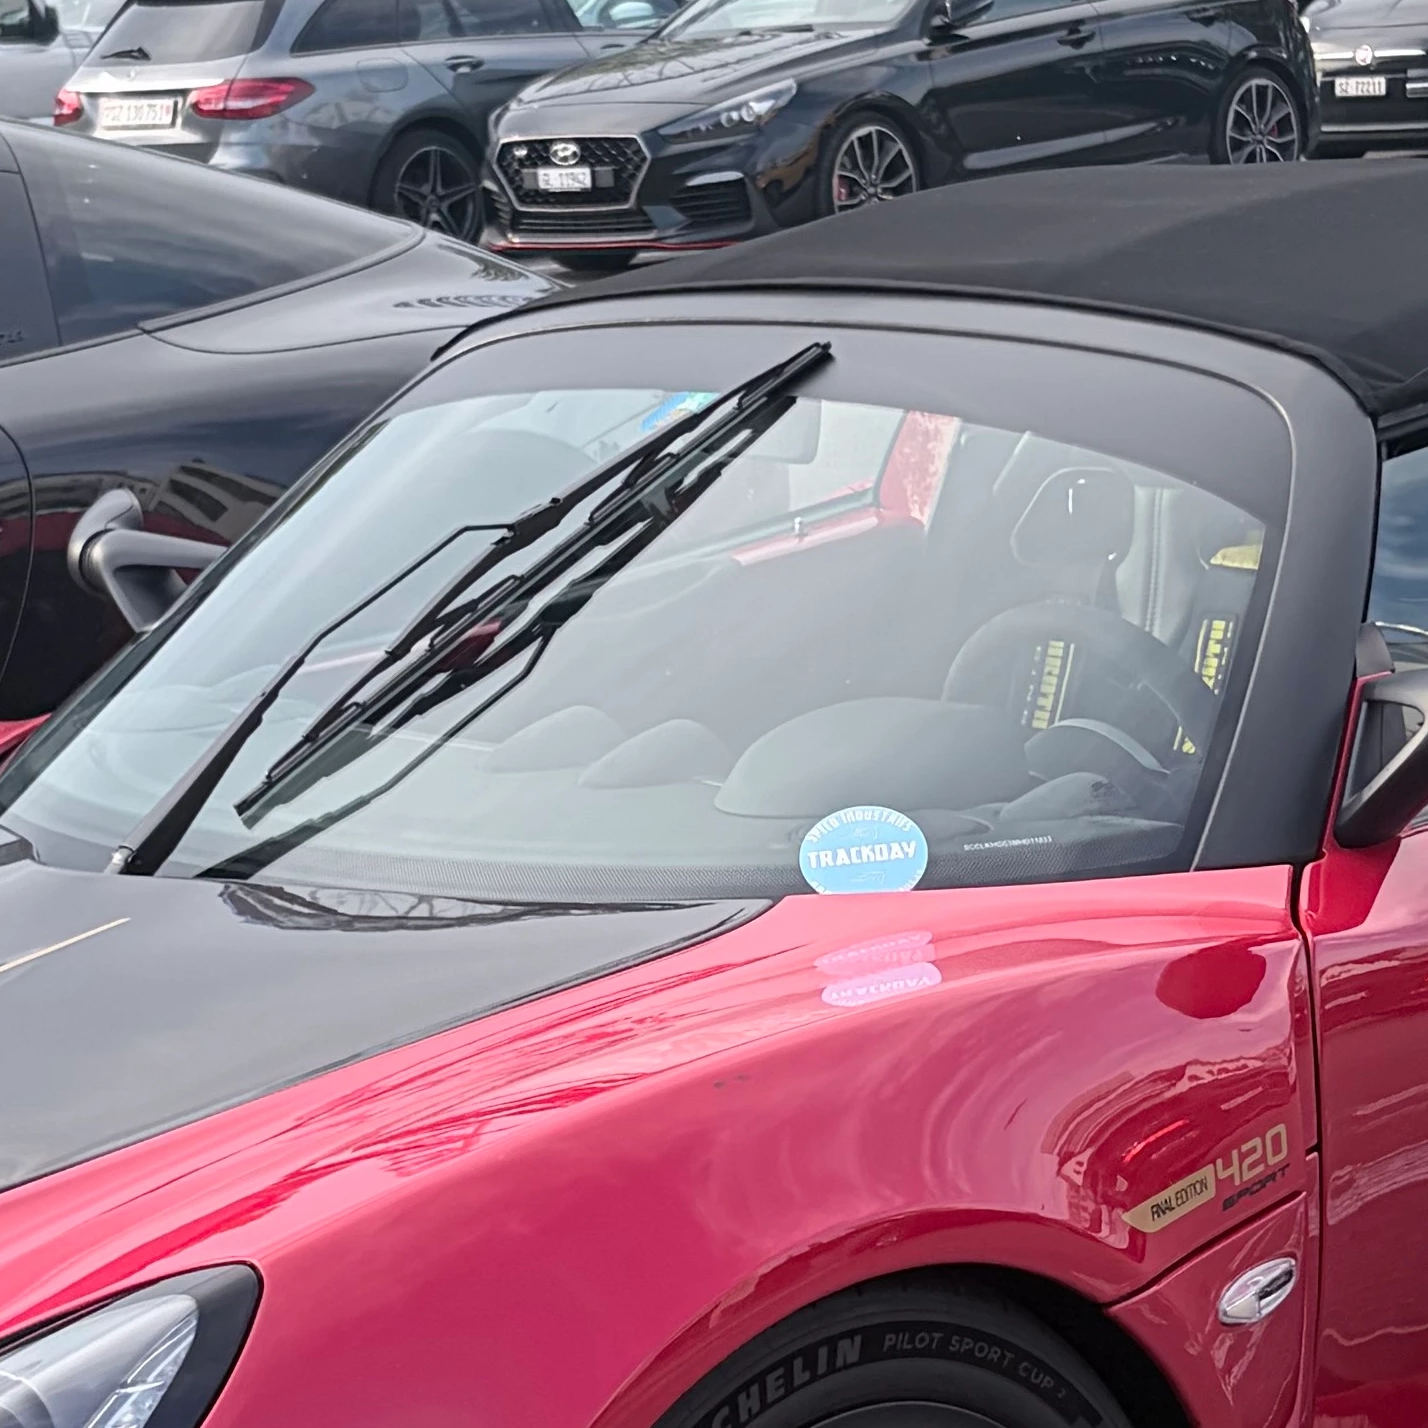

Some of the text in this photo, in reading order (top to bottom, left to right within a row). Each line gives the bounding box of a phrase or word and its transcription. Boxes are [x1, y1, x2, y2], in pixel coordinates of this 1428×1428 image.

[807, 840, 917, 869] TRACKDAY
[1215, 1123, 1288, 1187] 420
[882, 1332, 944, 1353] PILOT
[949, 1335, 1015, 1369] SPORT
[1018, 1351, 1054, 1390] CUP
